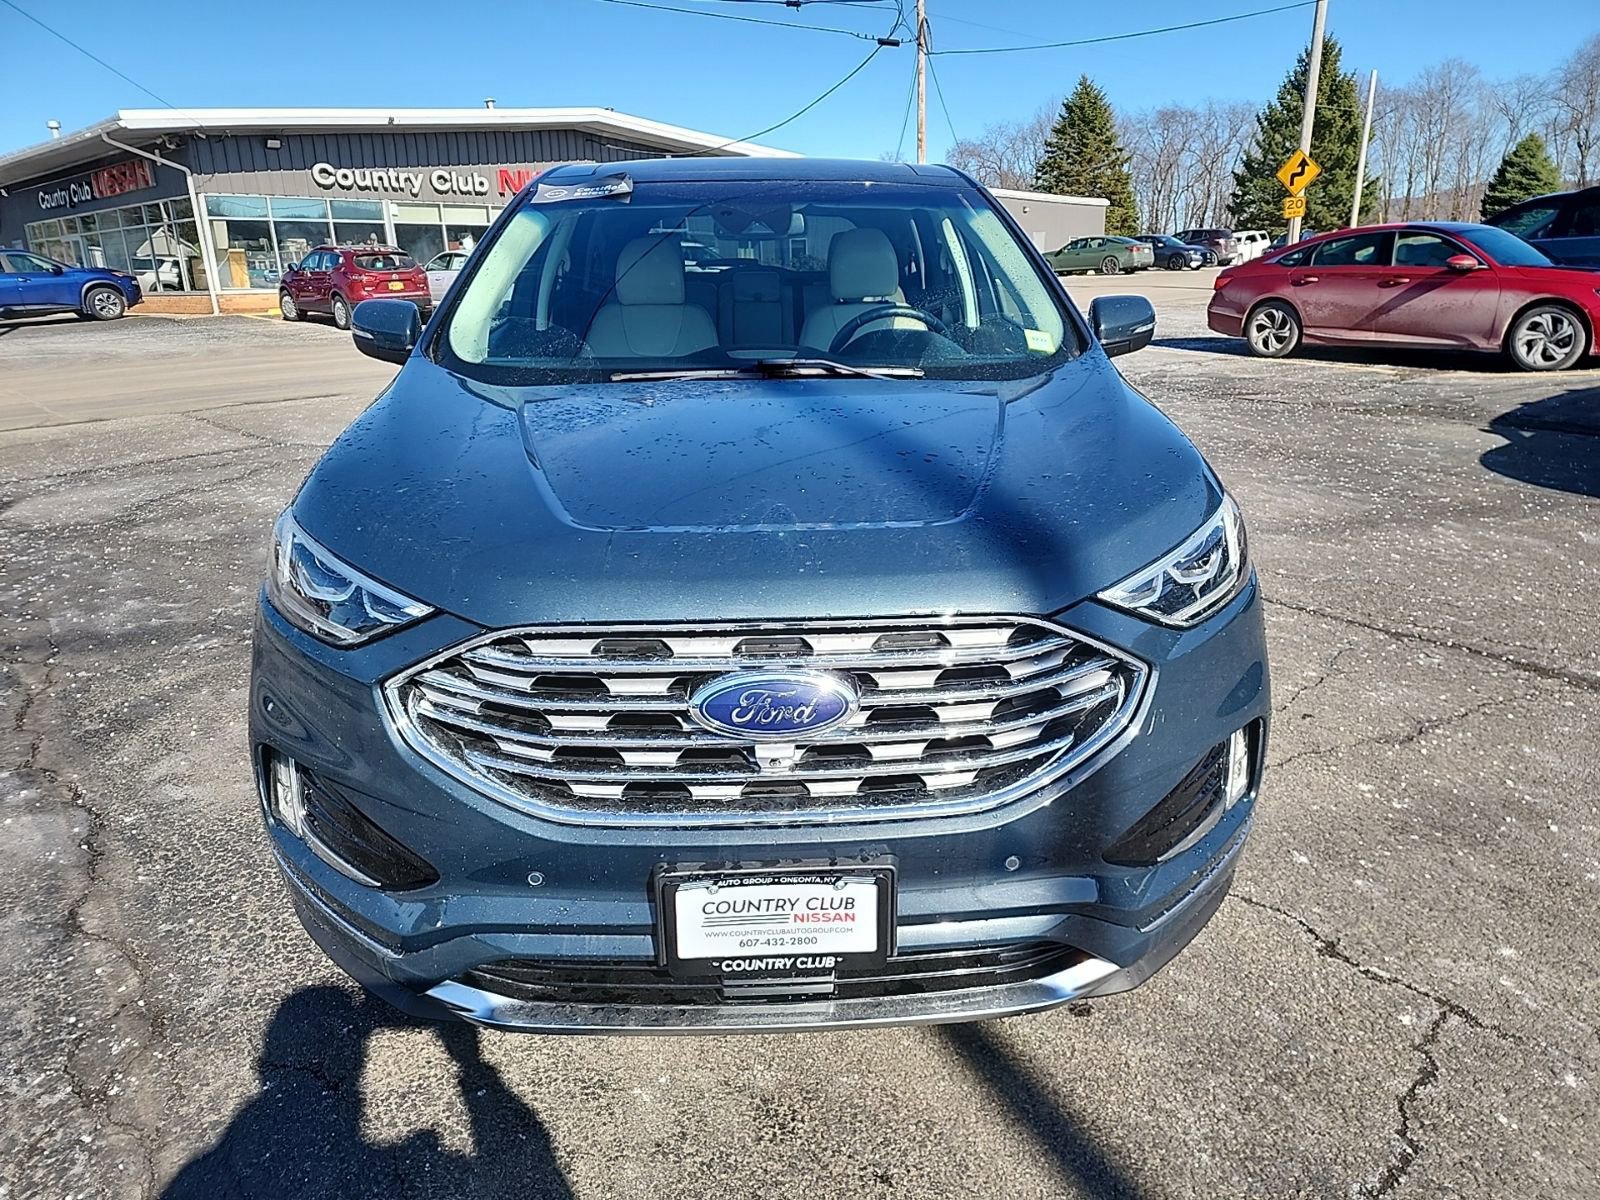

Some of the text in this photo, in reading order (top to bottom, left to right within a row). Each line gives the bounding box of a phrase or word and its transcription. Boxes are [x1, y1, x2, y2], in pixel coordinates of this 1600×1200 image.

[311, 162, 424, 196] Country
[430, 170, 490, 194] Club
[38, 188, 70, 209] Country
[70, 181, 92, 203] Club
[1287, 199, 1303, 209] 20
[731, 689, 818, 725] Ford
[717, 878, 741, 887] AUTO
[742, 877, 773, 885] GROUP
[702, 896, 856, 915] COUNTRY CLUB
[793, 912, 855, 923] NISSAN
[738, 936, 818, 948] 607-432-2800
[721, 956, 836, 973] COUNTRY CLUB
